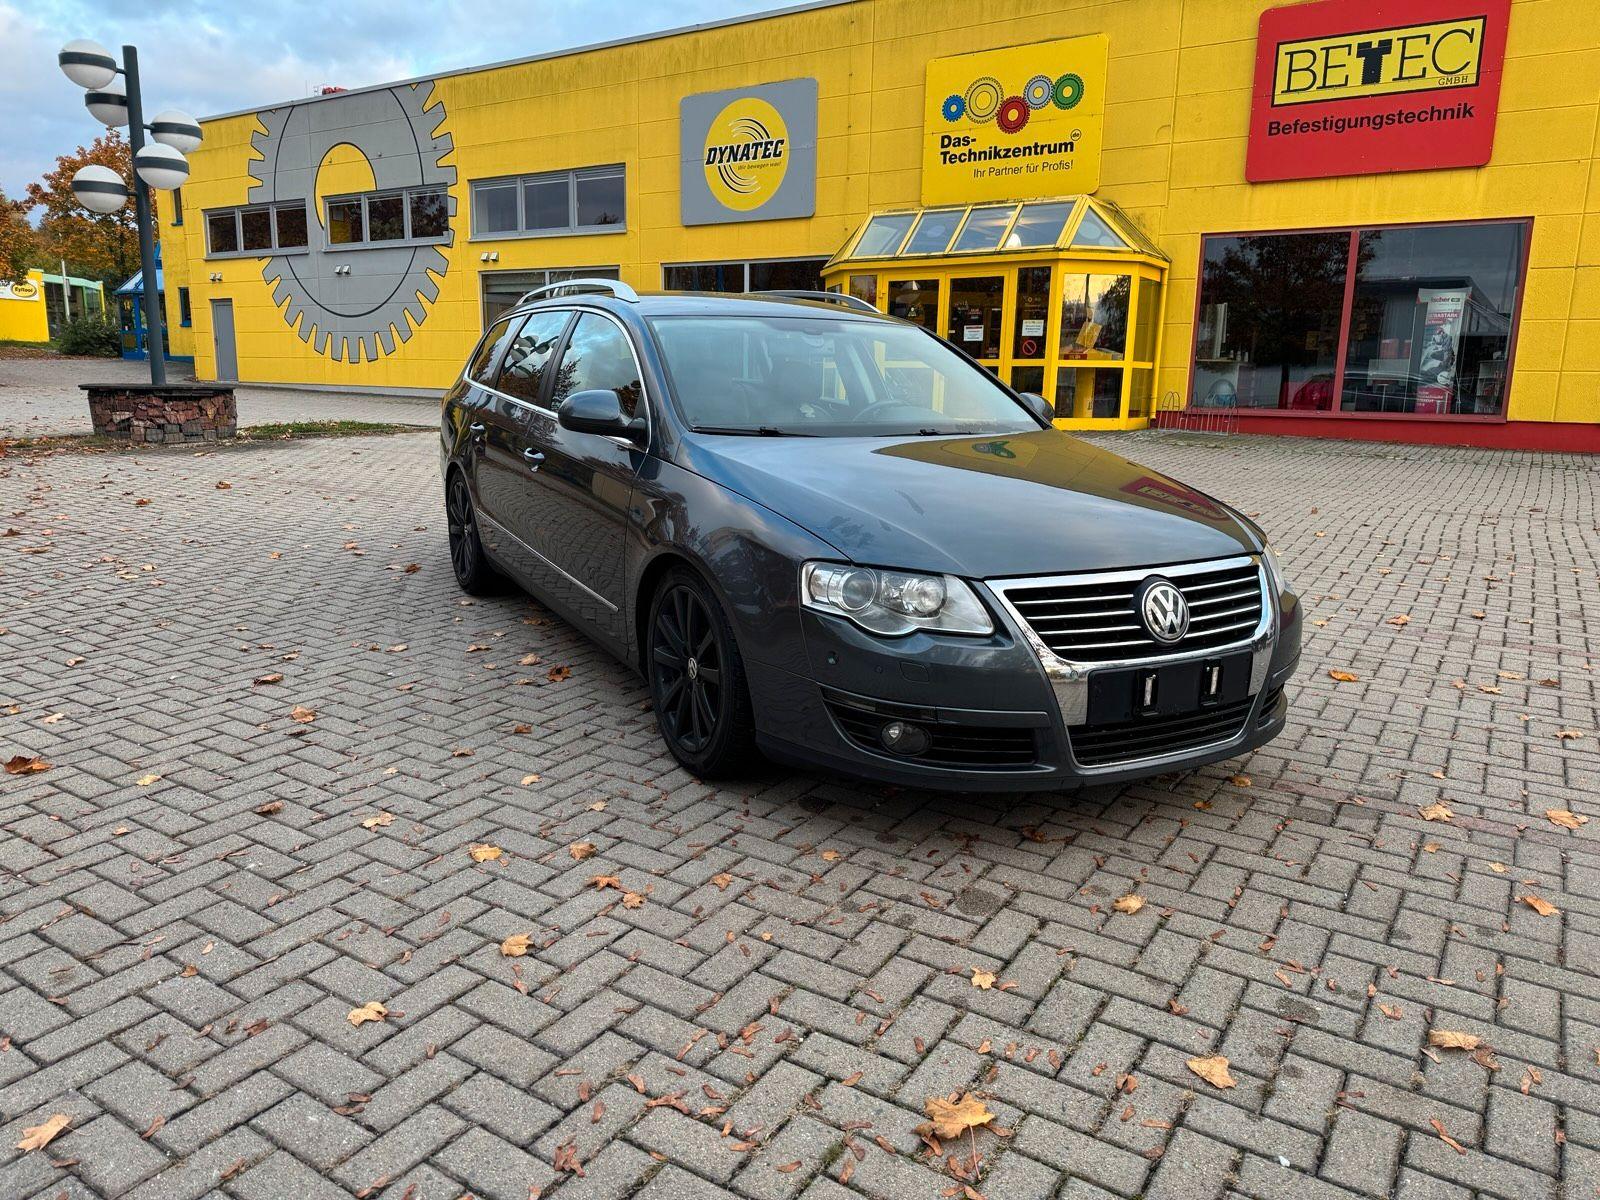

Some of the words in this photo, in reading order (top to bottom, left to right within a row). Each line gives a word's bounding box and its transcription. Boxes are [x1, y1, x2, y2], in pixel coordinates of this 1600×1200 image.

[1280, 27, 1476, 94] BETEC
[1438, 75, 1469, 86] GMBH
[1267, 103, 1475, 137] Befestigungstechnik
[705, 139, 785, 166] DYNATEC
[940, 134, 977, 149] Das-
[940, 140, 1075, 165] Technikzentrum
[973, 168, 986, 178] Ihr
[988, 165, 1024, 177] Partner
[1025, 162, 1039, 173] für
[1041, 159, 1074, 172] Profis!
